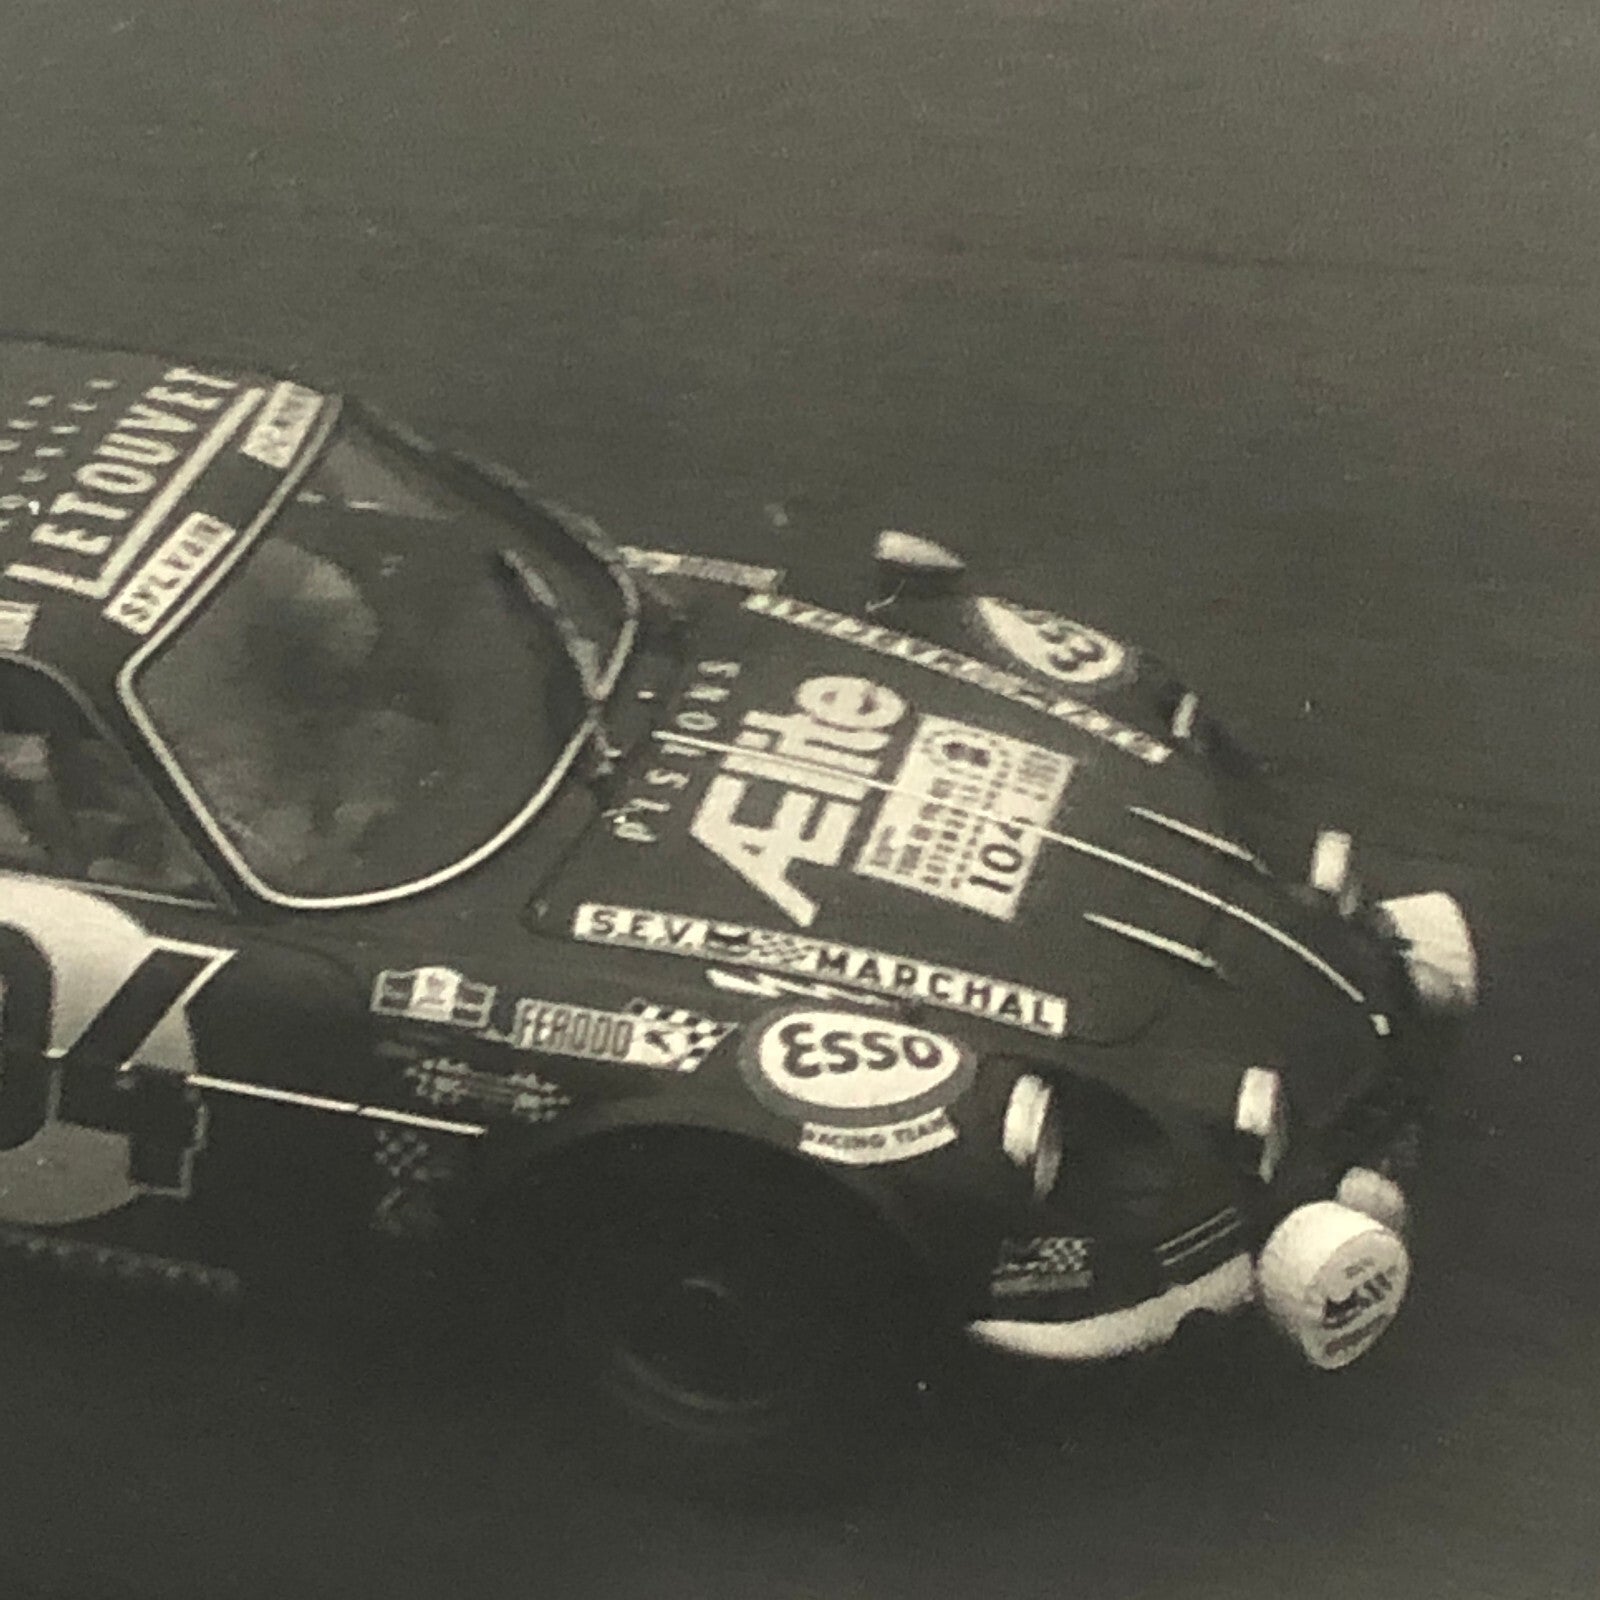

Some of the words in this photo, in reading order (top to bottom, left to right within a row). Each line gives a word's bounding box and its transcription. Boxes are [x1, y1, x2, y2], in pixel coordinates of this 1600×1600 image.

[968, 815, 1034, 894] 104
[592, 908, 693, 945] SEV
[815, 949, 1056, 1031] MARCHAL
[519, 1003, 635, 1059] FERODO
